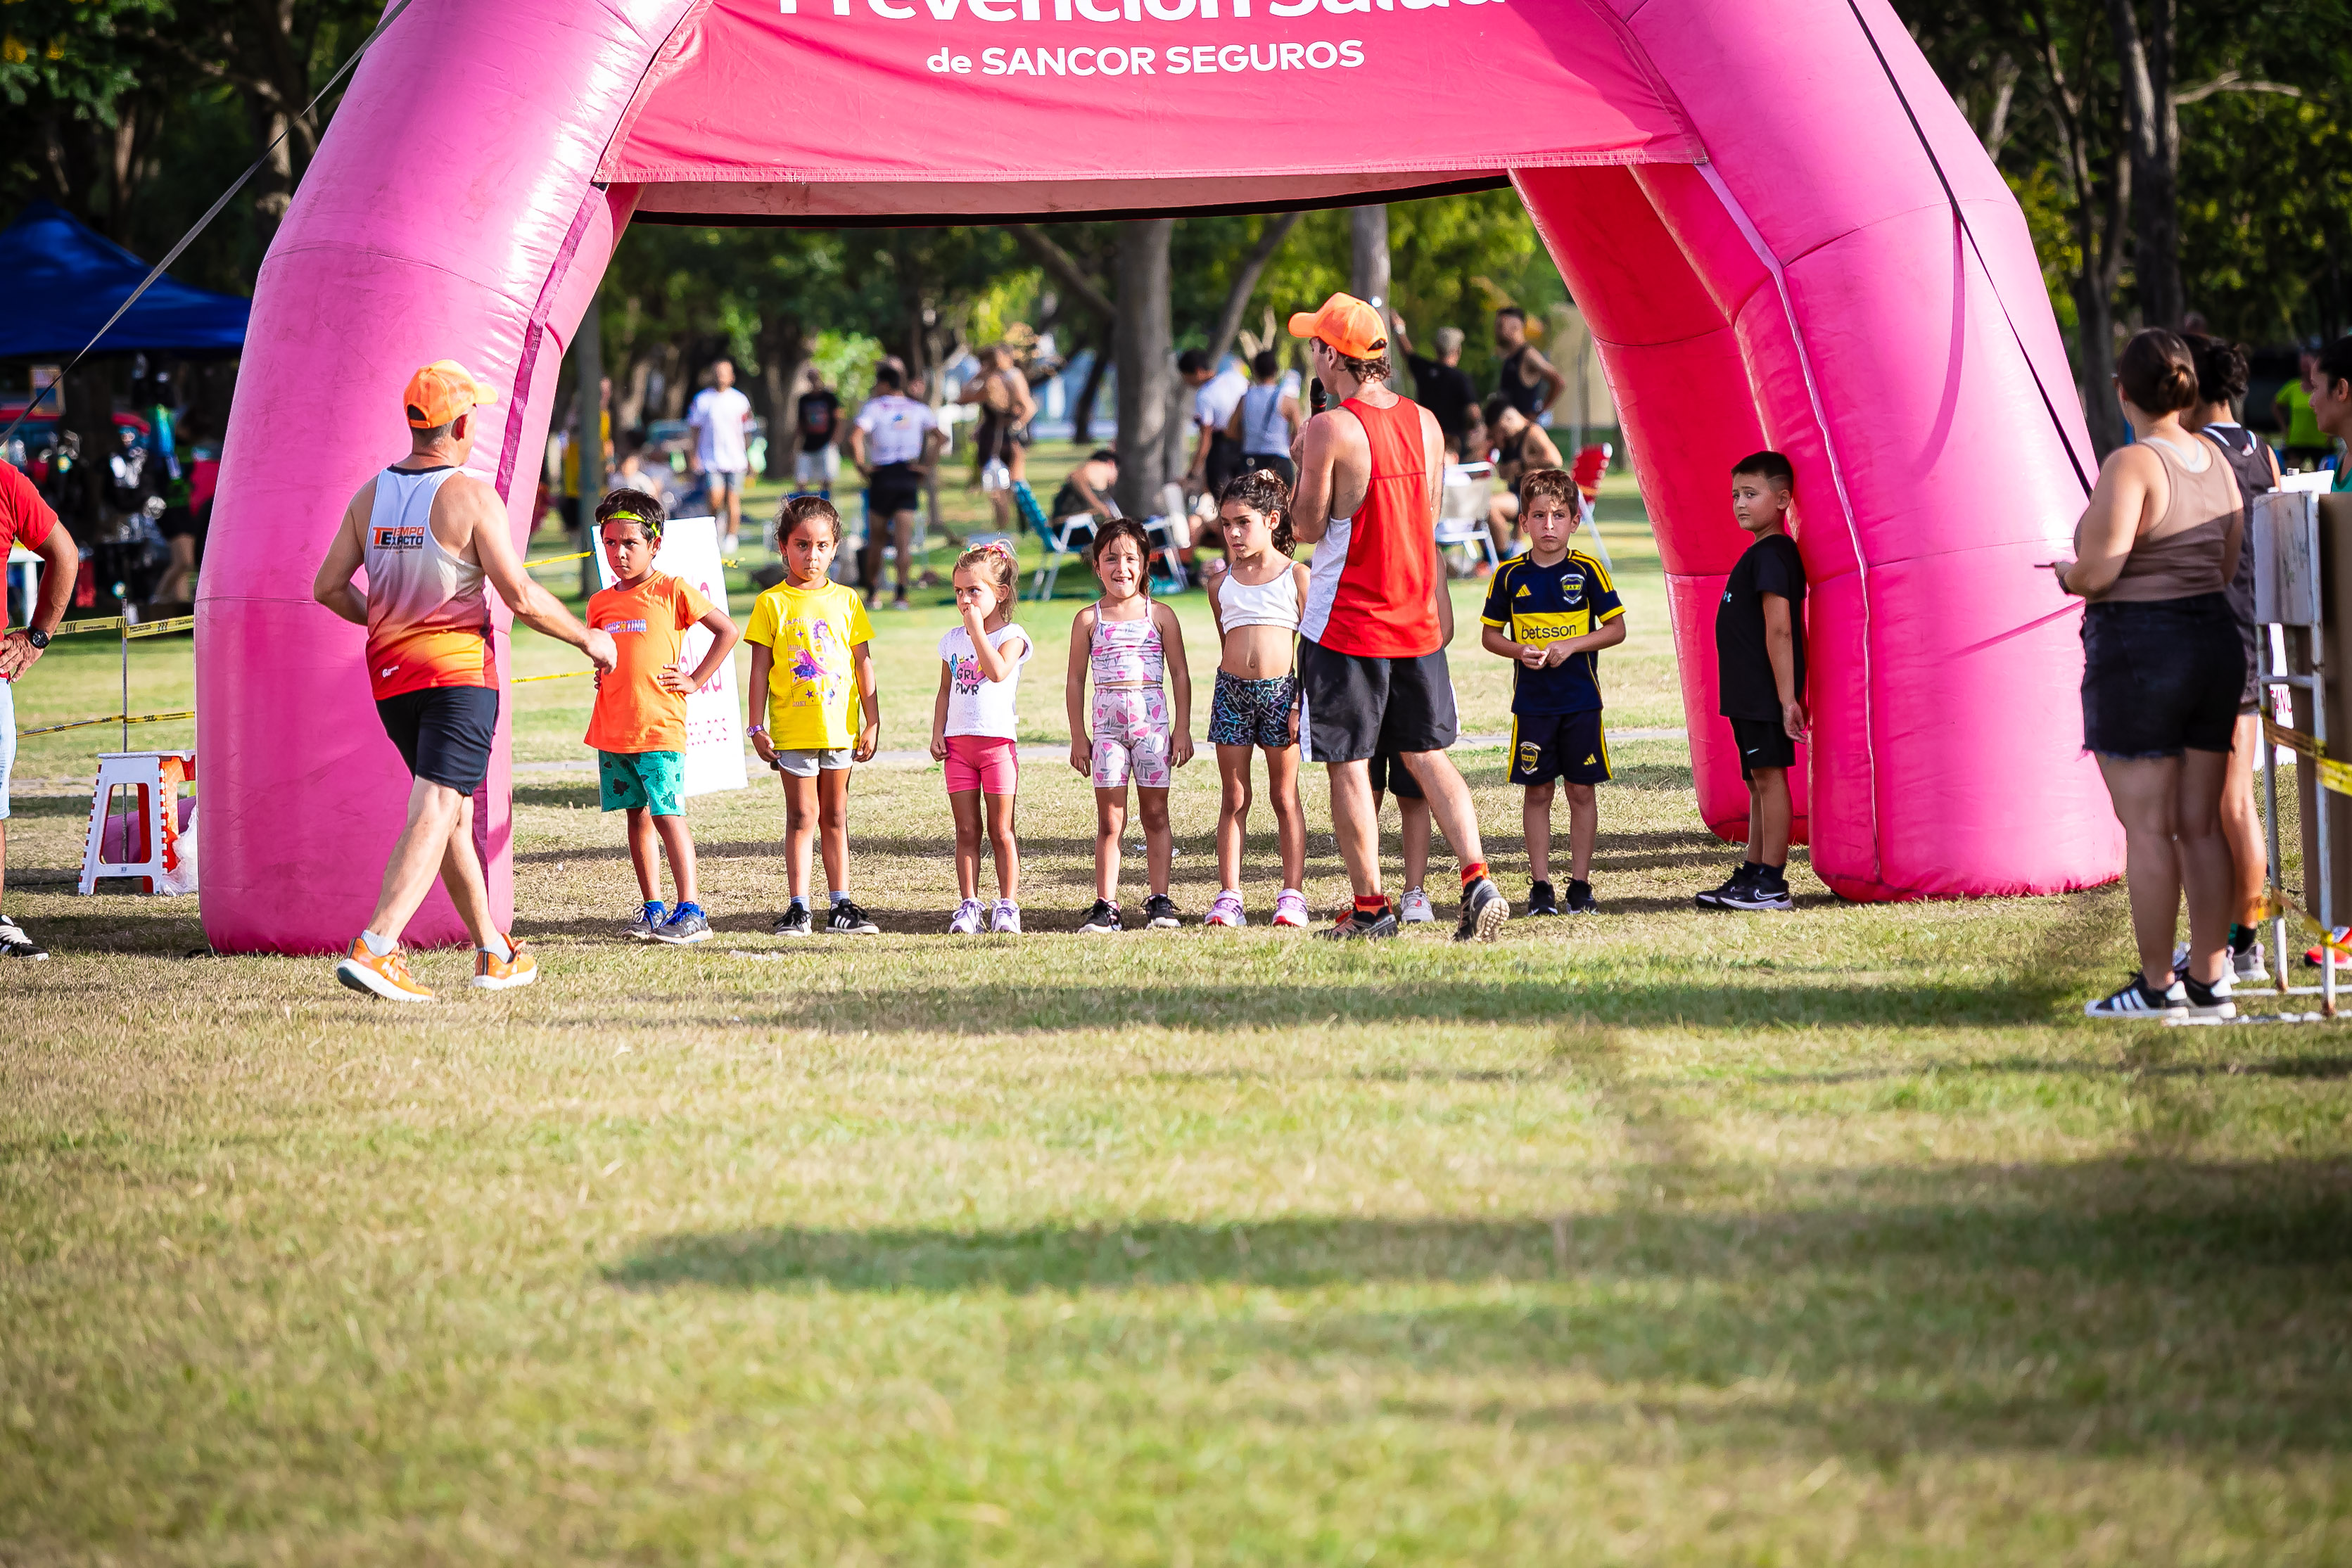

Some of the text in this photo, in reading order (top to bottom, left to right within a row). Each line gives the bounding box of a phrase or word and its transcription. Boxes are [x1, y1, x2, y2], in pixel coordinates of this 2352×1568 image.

[926, 39, 1365, 76] de SANCOR SEGUROS
[1521, 624, 1577, 640] betsson
[957, 668, 977, 680] GRL
[955, 682, 979, 696] PWR
